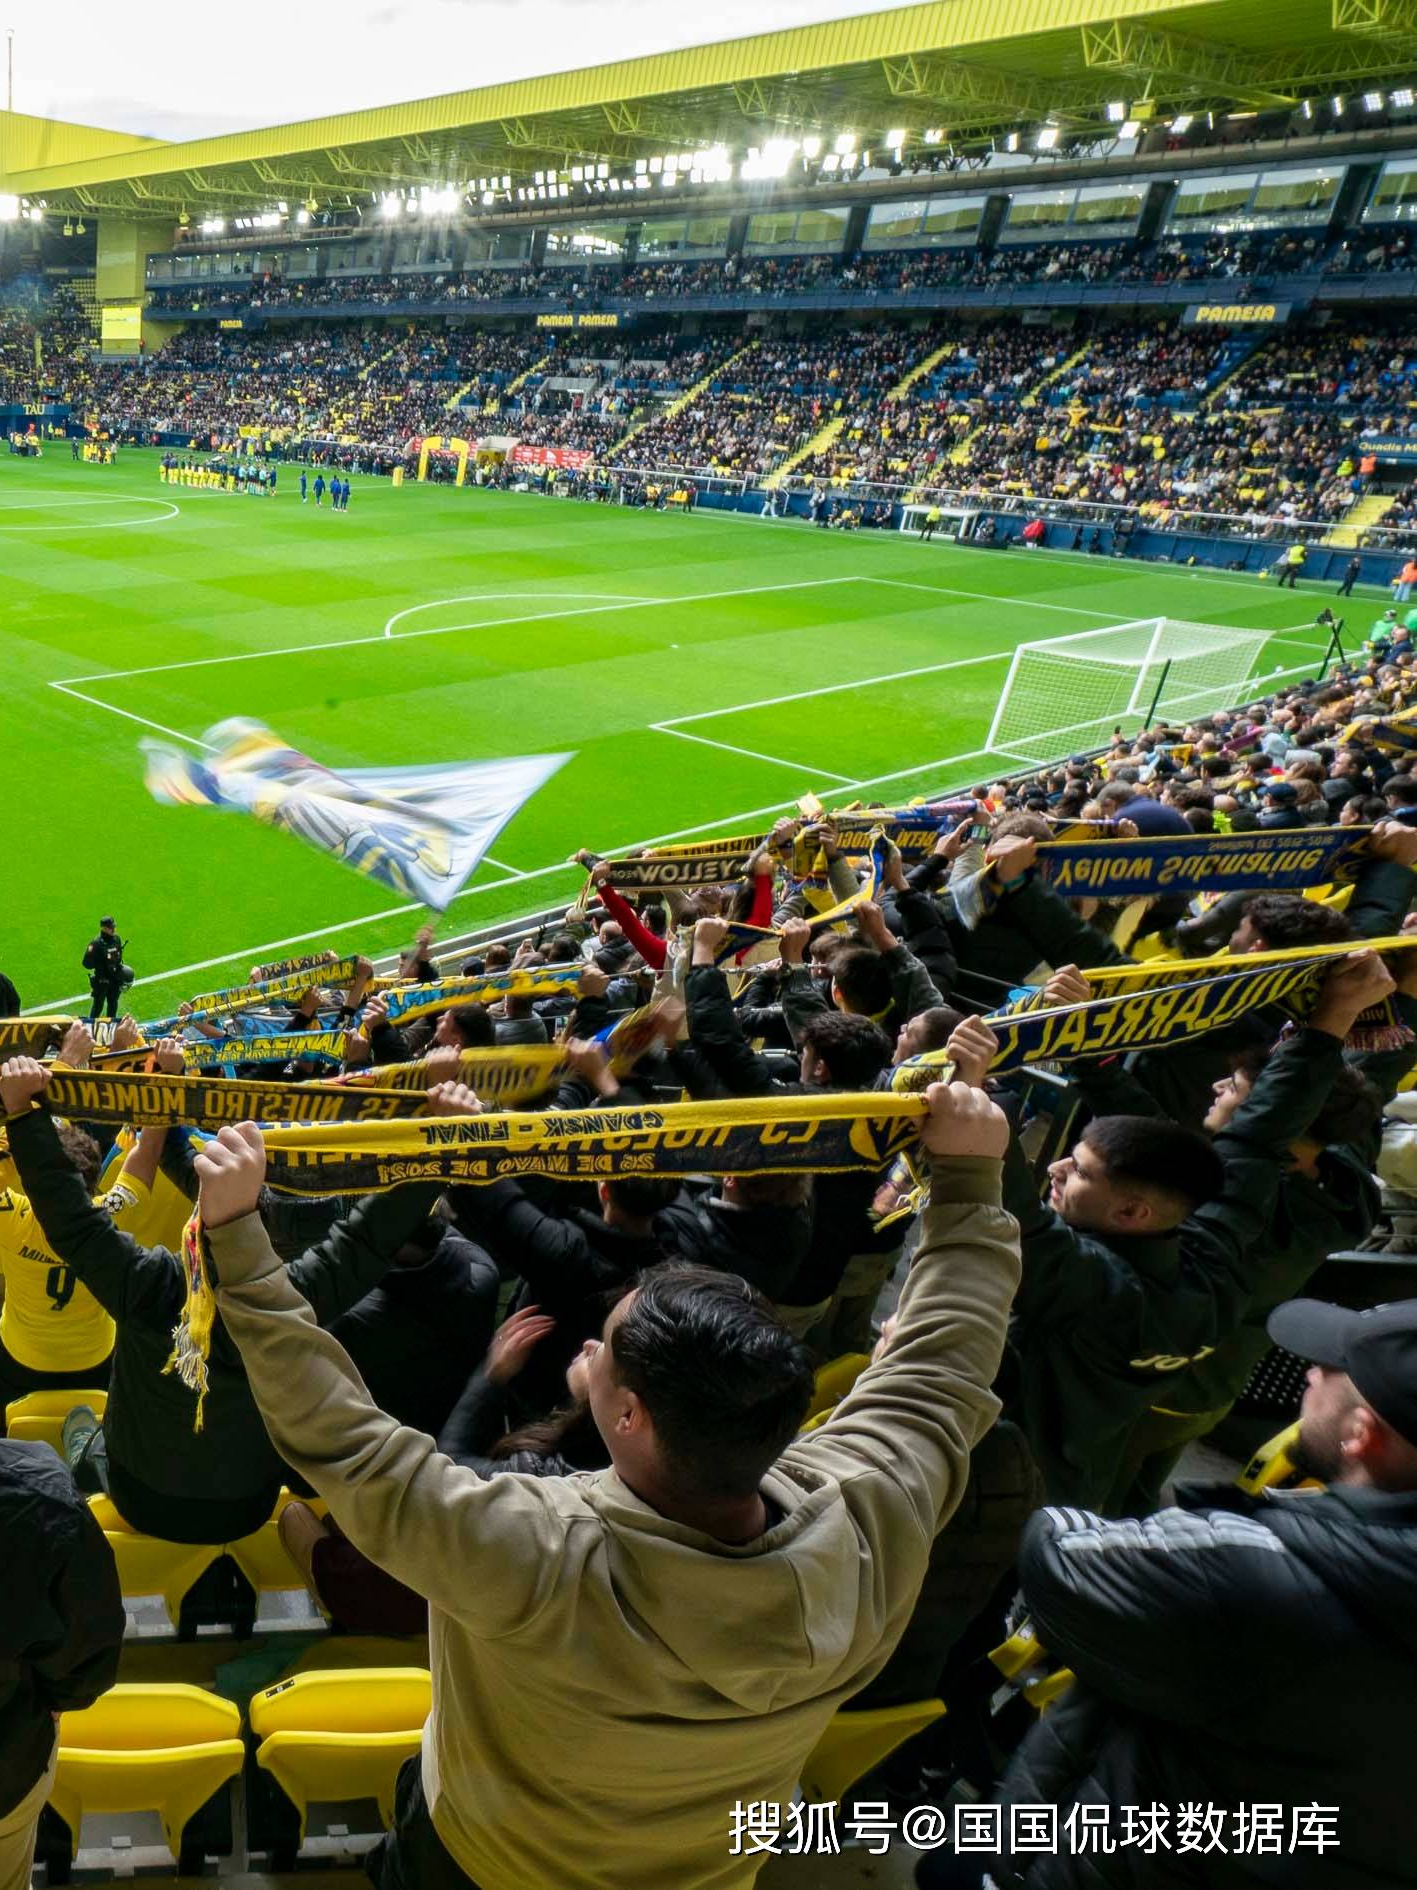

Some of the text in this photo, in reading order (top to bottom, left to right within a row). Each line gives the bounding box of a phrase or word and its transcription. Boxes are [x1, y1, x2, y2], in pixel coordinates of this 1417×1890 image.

[1195, 305, 1276, 323] PAMESA
[23, 403, 45, 416] TAU
[419, 1119, 510, 1145] FINAL
[542, 1111, 664, 1137] GDANSK
[46, 1266, 77, 1312] 9
